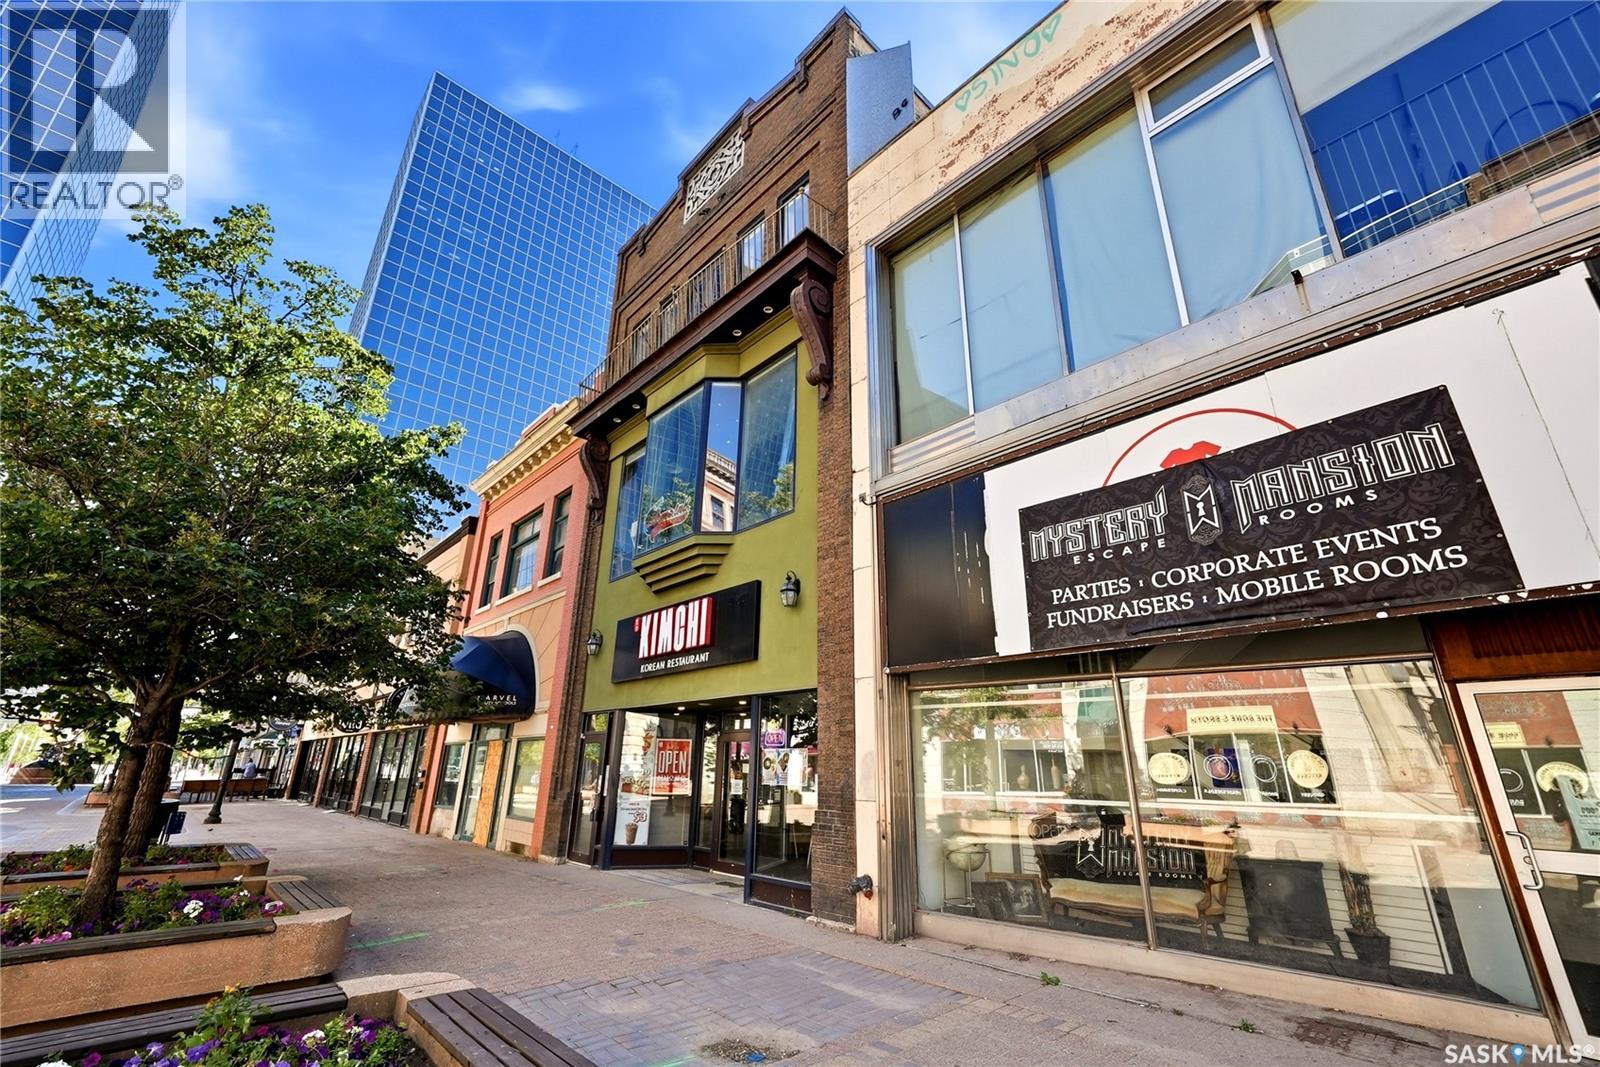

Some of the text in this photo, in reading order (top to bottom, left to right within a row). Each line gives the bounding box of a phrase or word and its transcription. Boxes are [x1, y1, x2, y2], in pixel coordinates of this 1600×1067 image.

[1029, 422, 1456, 562] MYSTERY MANSION
[1051, 517, 1442, 605] PARTIES CORPORATE EVENTS
[1073, 489, 1378, 565] ESCAPE ROOMS
[1047, 545, 1469, 628] FUNDRAISERS MOBILE ROOMS
[638, 597, 712, 659] KIMCHI
[640, 652, 710, 673] KOREAN RESTAURANT
[475, 694, 518, 702] ARVEL
[658, 750, 687, 774] OPEN
